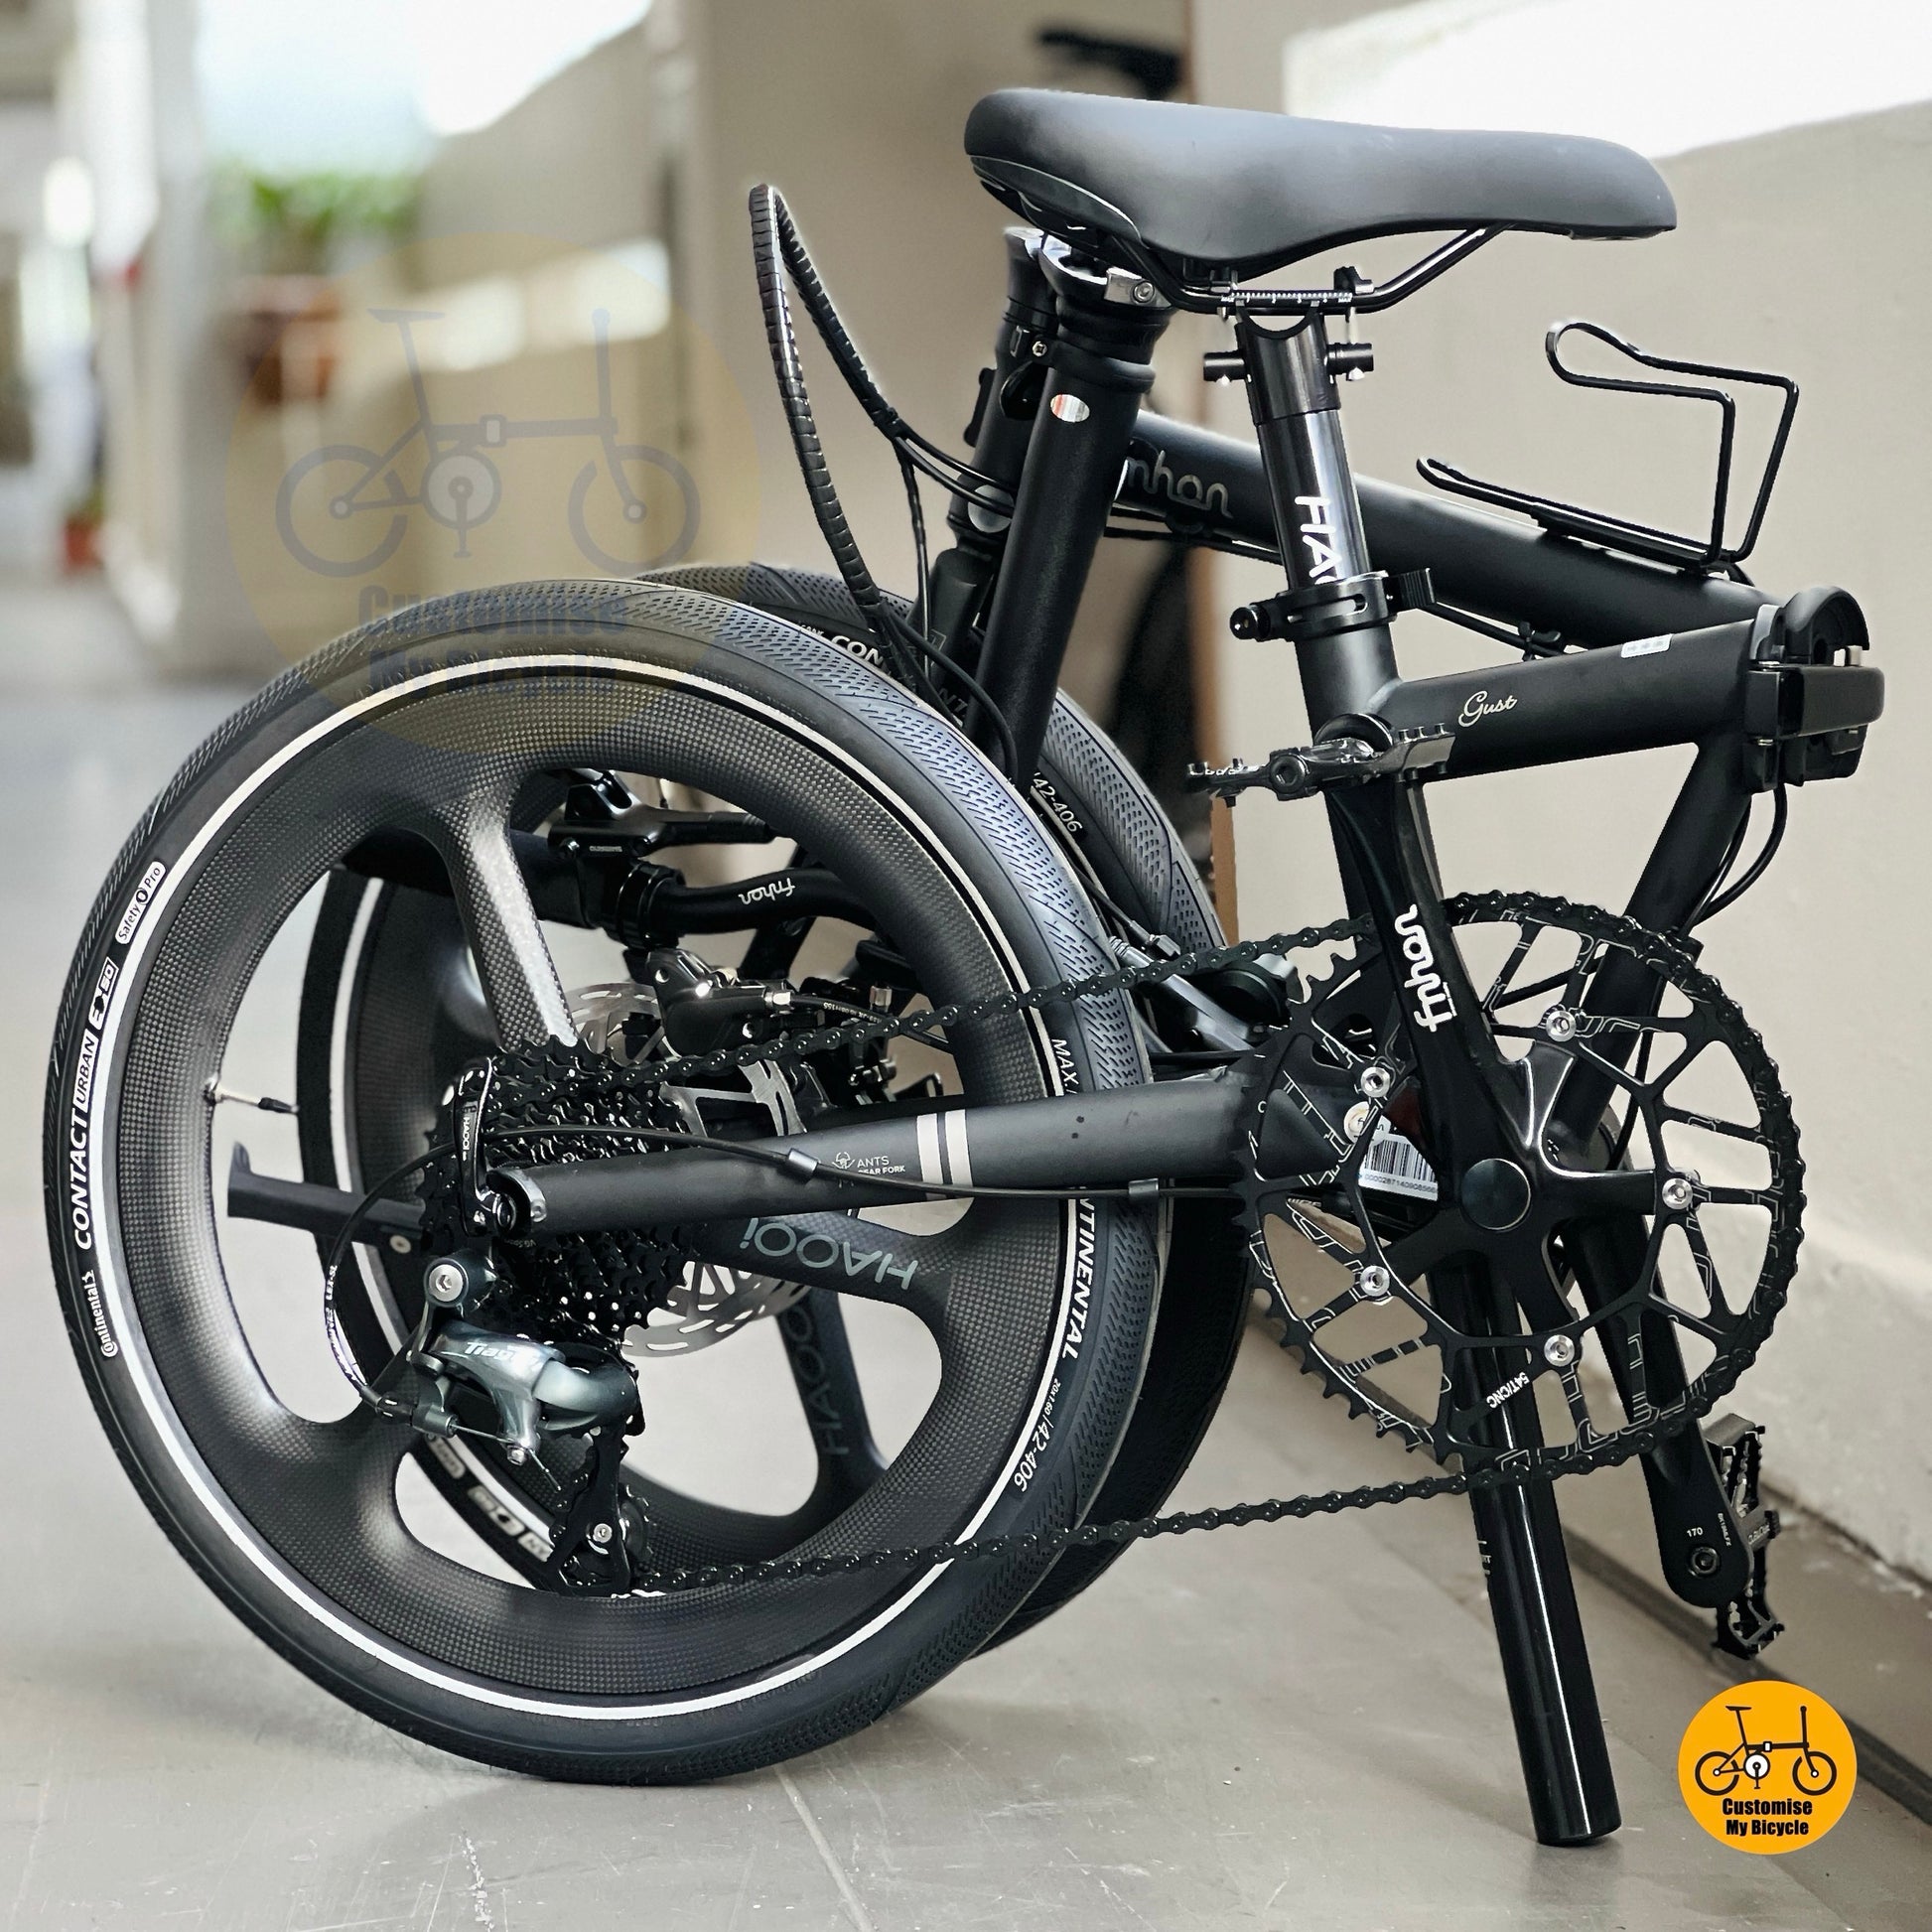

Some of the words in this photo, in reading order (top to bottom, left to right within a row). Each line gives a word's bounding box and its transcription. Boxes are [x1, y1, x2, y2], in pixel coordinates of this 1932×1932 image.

[1458, 690, 1519, 728] Gust
[118, 904, 141, 942] Safety
[144, 867, 162, 890] Pro
[75, 1035, 96, 1105] URBAN
[69, 1107, 92, 1251] CONTACT
[857, 1155, 891, 1169] ANTS
[882, 1165, 906, 1174] FORK
[83, 1280, 119, 1358] Continental
[1486, 1371, 1531, 1409] 54T/CNC
[1687, 1526, 1705, 1538] 170
